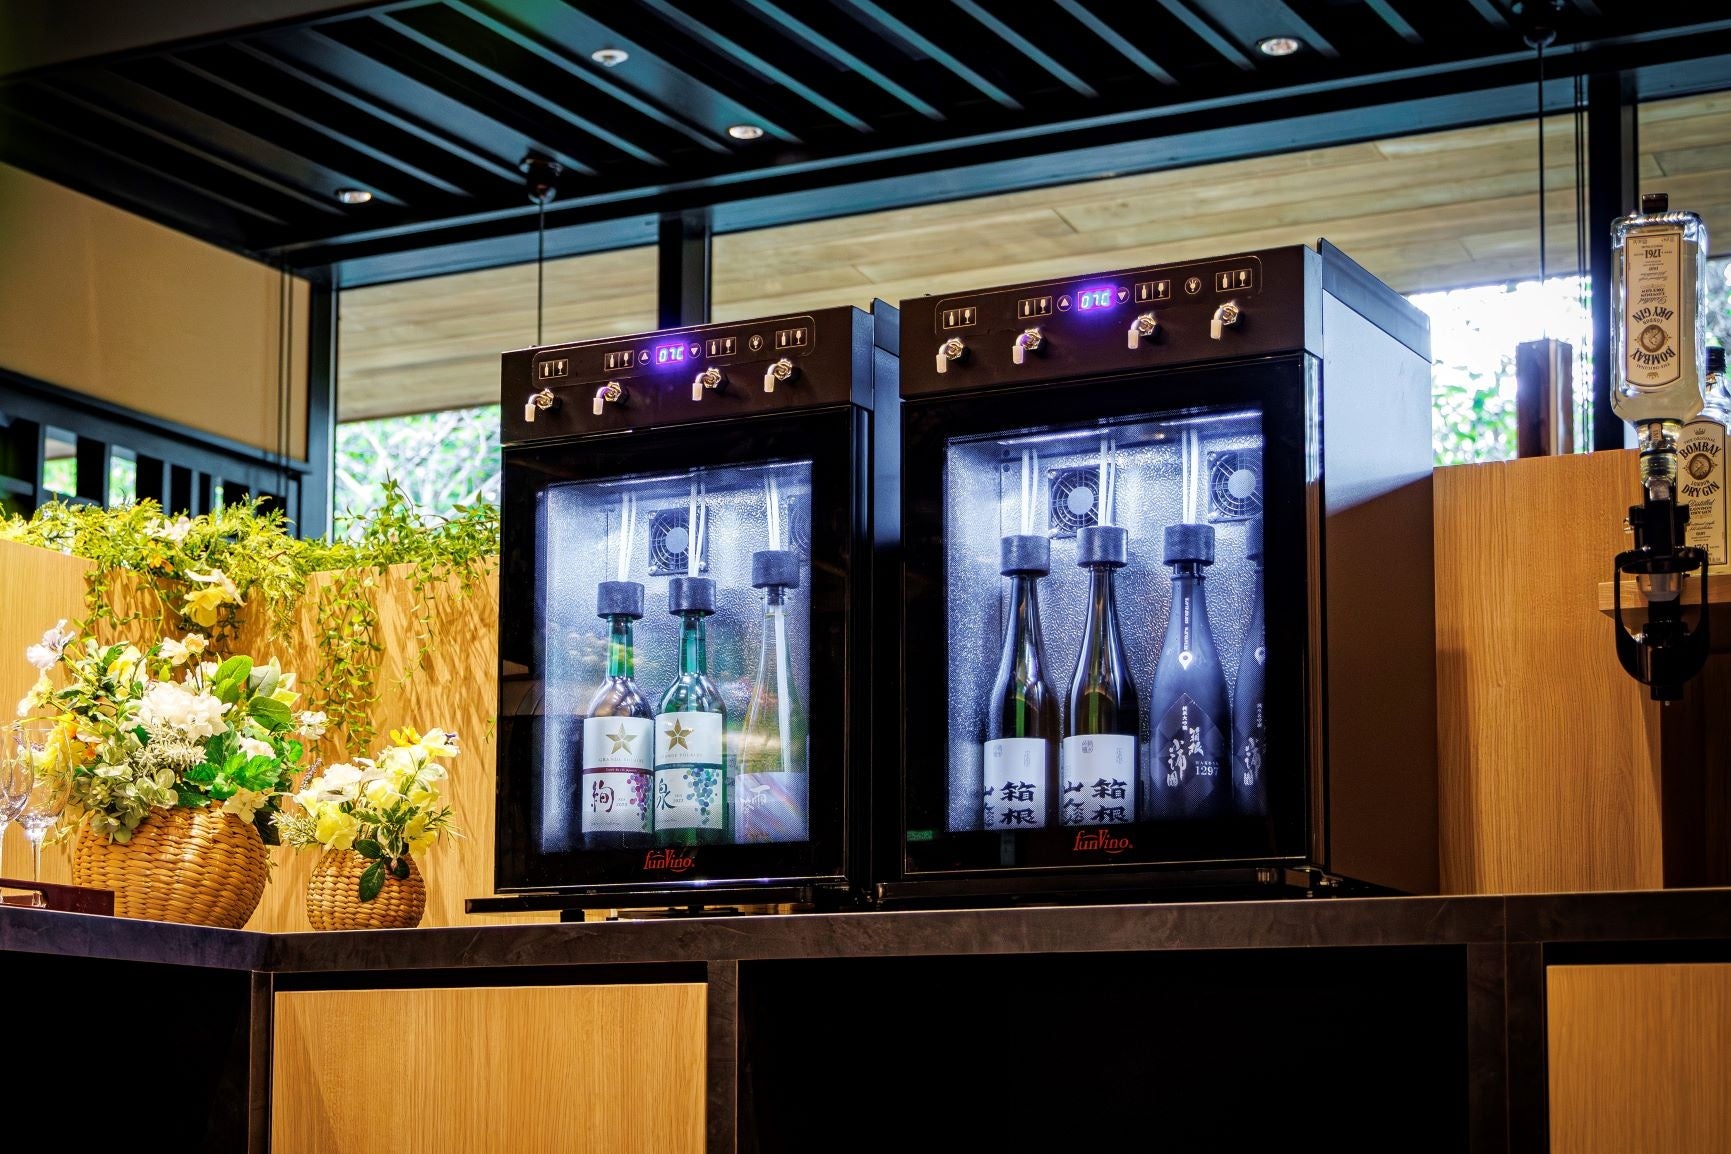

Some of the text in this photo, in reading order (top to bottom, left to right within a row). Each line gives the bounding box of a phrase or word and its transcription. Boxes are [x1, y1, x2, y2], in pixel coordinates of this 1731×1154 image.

[1645, 249, 1661, 258] 1761
[1632, 306, 1674, 323] DRY GIN
[1630, 346, 1676, 364] BOMBAY
[1679, 442, 1722, 460] BOMBAY
[1681, 480, 1720, 498] DRY GIN
[1196, 766, 1218, 776] 1297
[656, 778, 676, 810] 泉
[1000, 780, 1036, 824] 箱根
[1090, 778, 1128, 822] 箱根
[1072, 830, 1129, 854] funVino
[643, 849, 692, 872] funVino
